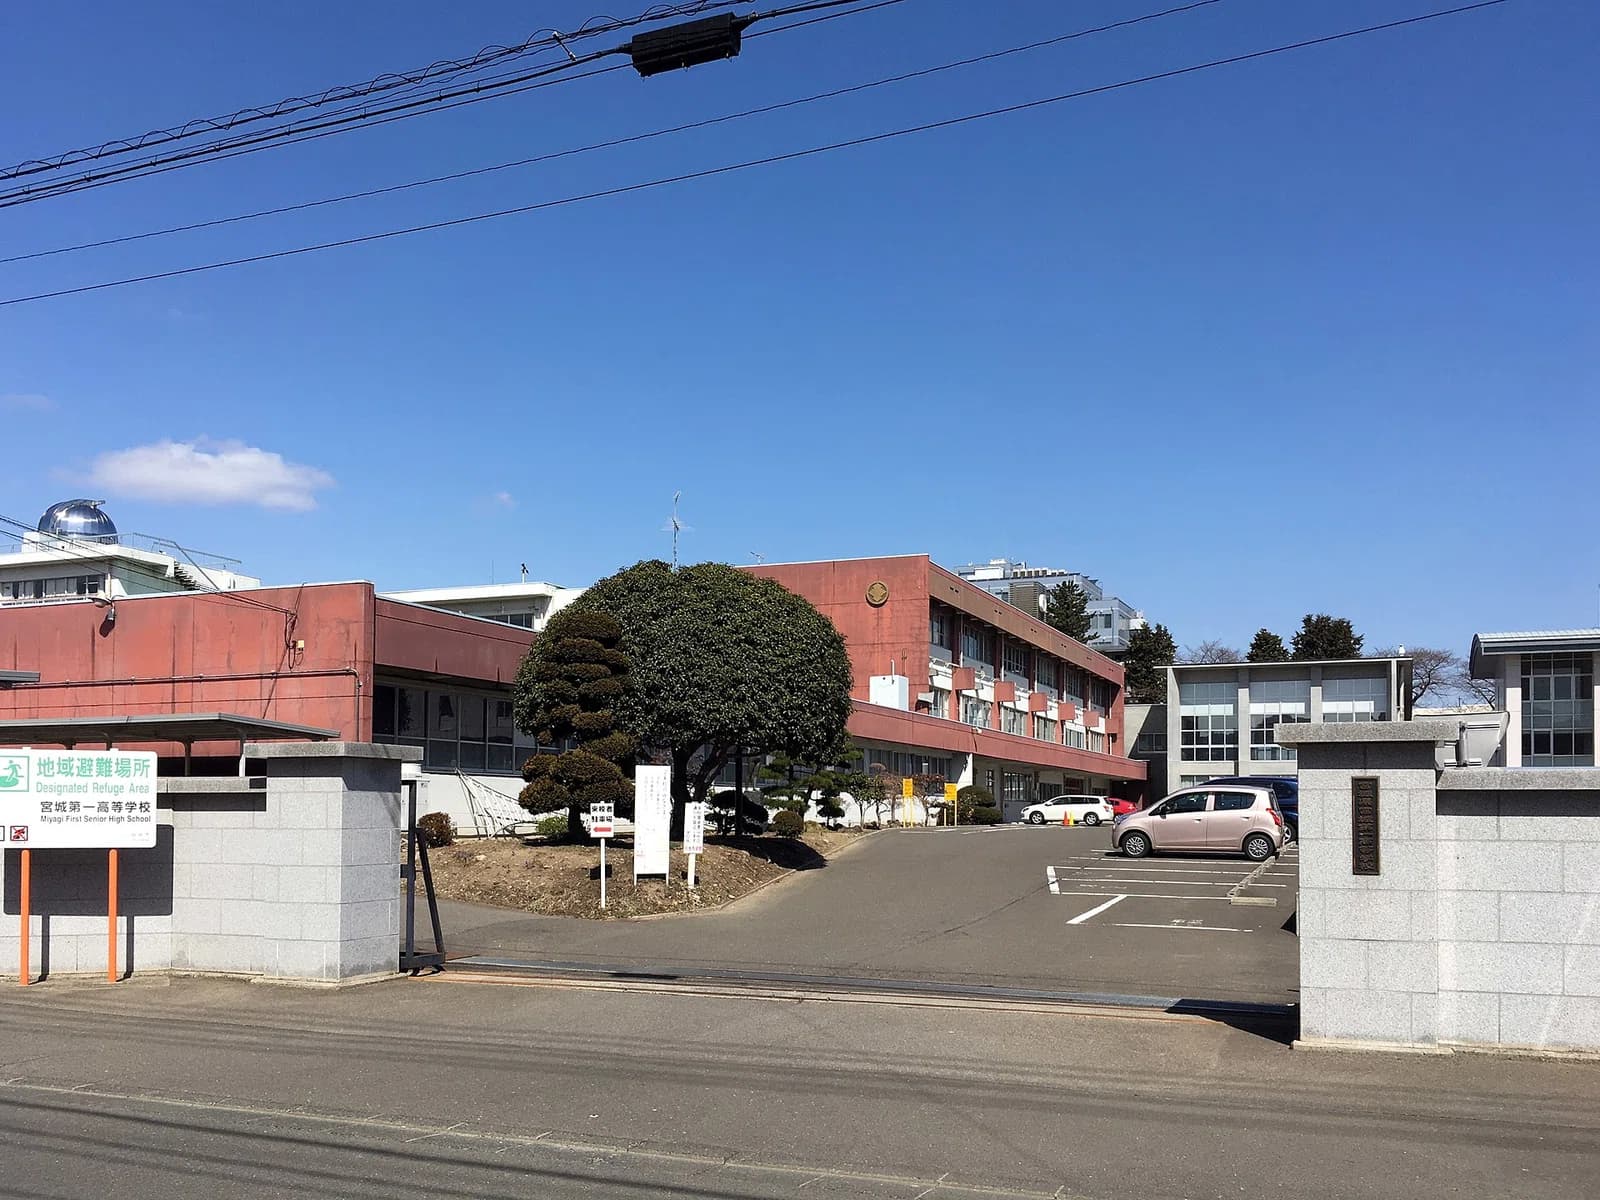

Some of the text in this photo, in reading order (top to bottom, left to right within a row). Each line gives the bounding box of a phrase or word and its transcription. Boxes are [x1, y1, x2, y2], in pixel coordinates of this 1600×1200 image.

[37, 757, 151, 778] 地域避難場所
[36, 782, 150, 796] Designated Refuge Area
[40, 801, 151, 813] 宮城第一高等学校
[40, 815, 151, 824] Miyagi First Senior High School
